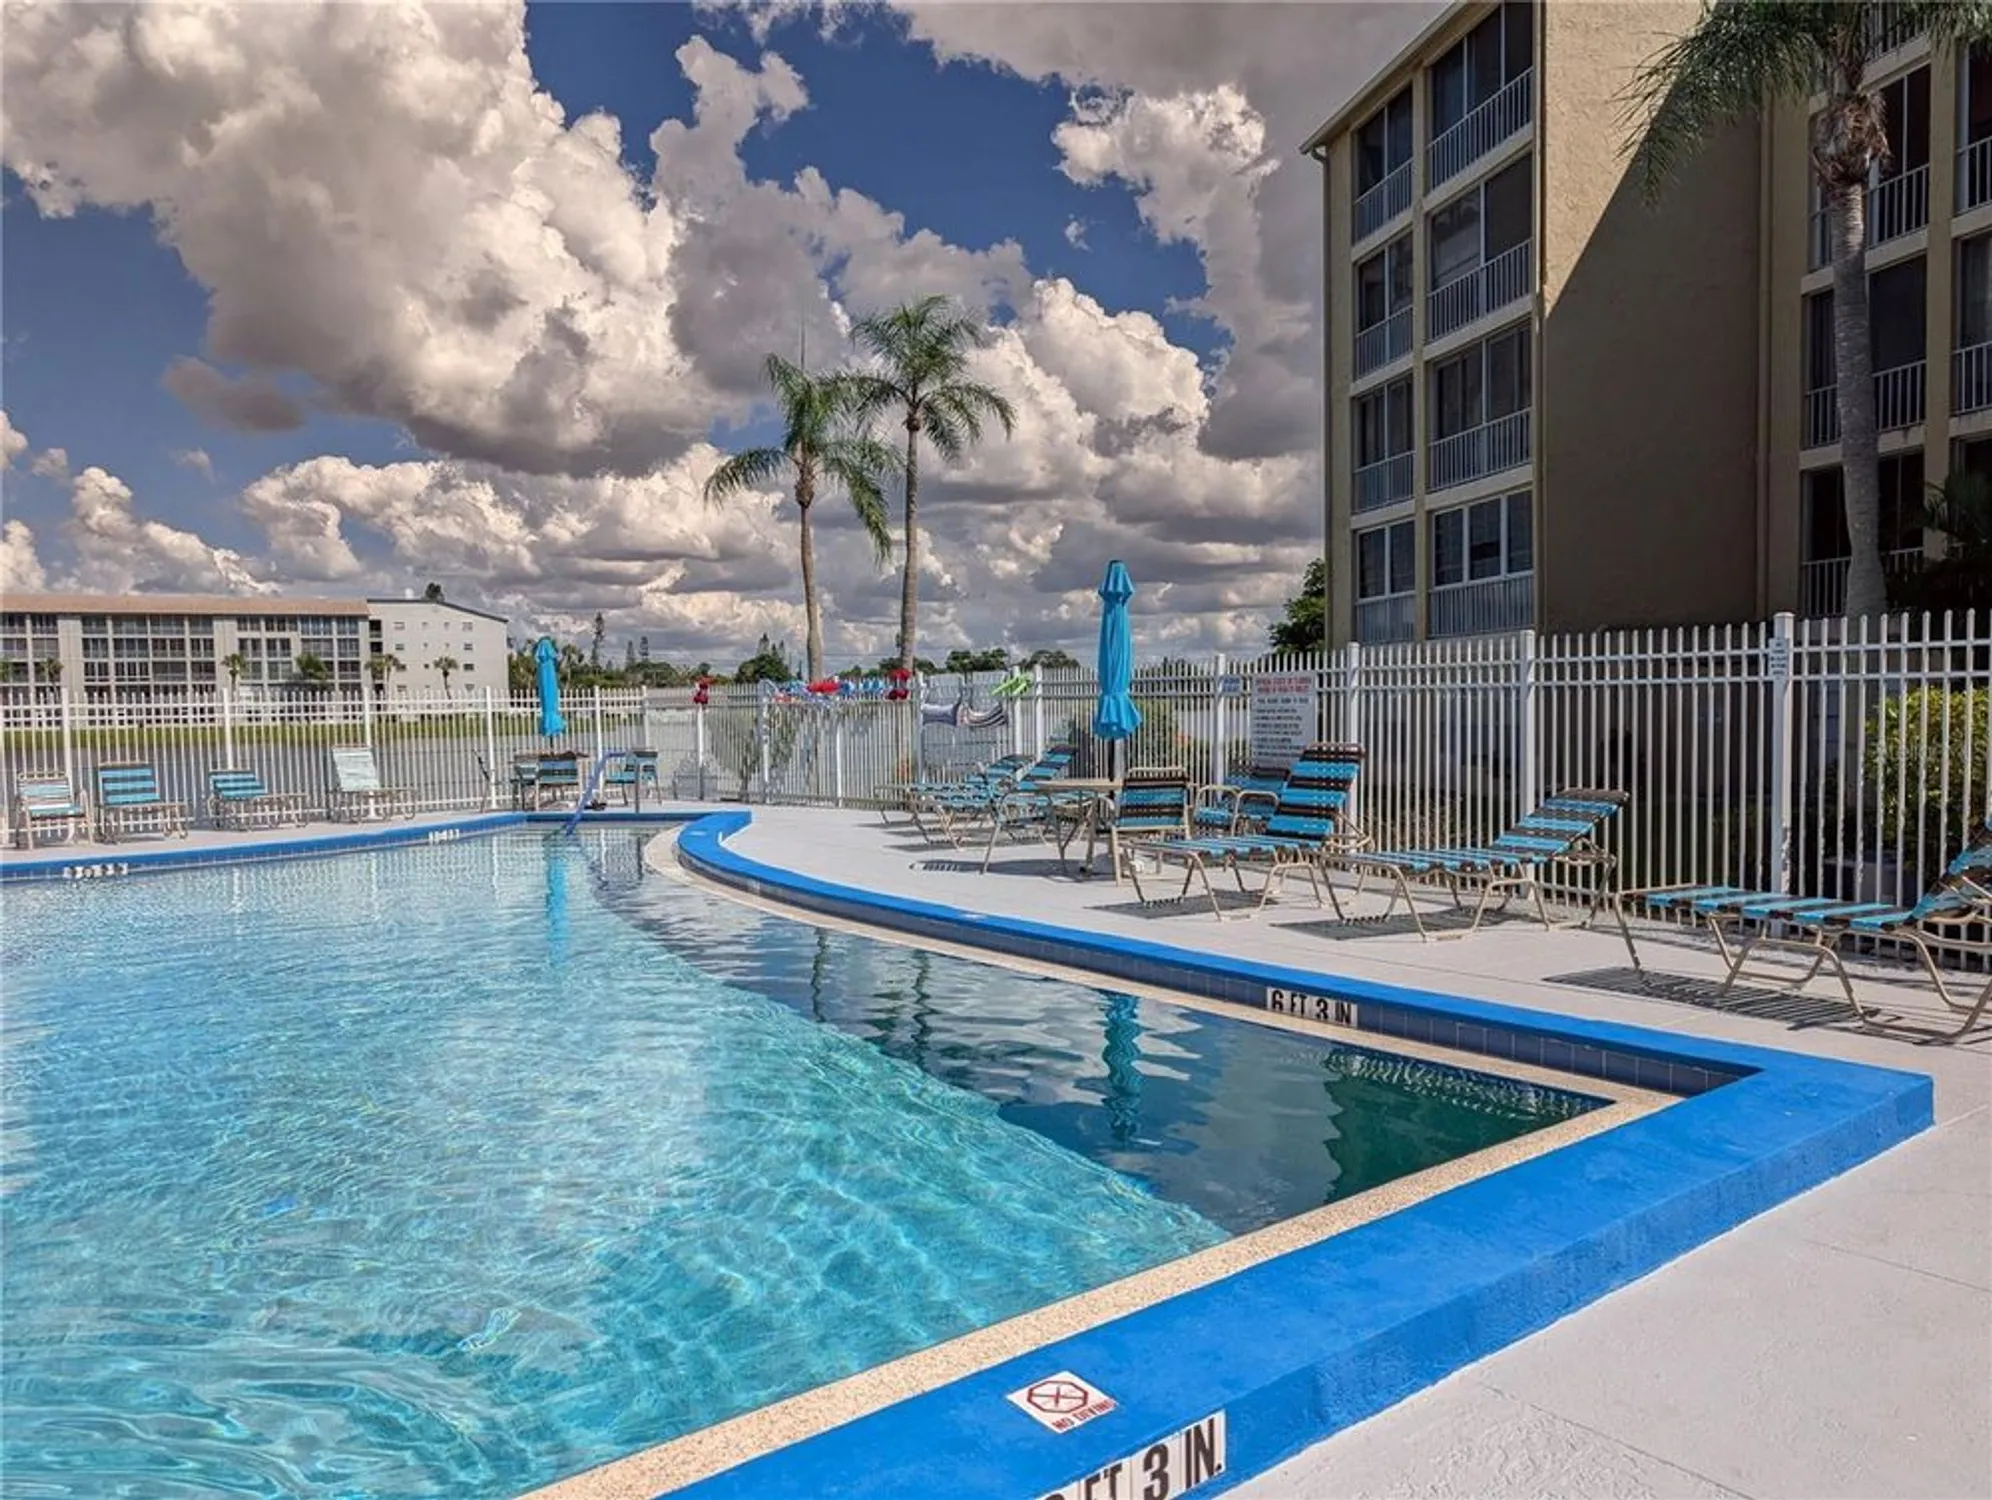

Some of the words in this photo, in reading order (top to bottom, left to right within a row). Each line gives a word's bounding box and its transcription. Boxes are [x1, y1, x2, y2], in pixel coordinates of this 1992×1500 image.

[1271, 989, 1285, 1012] 6
[1290, 992, 1308, 1018] FT
[1316, 998, 1329, 1021] 3
[1334, 1000, 1352, 1026] IN
[1051, 1416, 1075, 1431] NO
[1072, 1399, 1117, 1421] DIVING
[1143, 1443, 1169, 1500] 3
[1184, 1417, 1223, 1490] IN.
